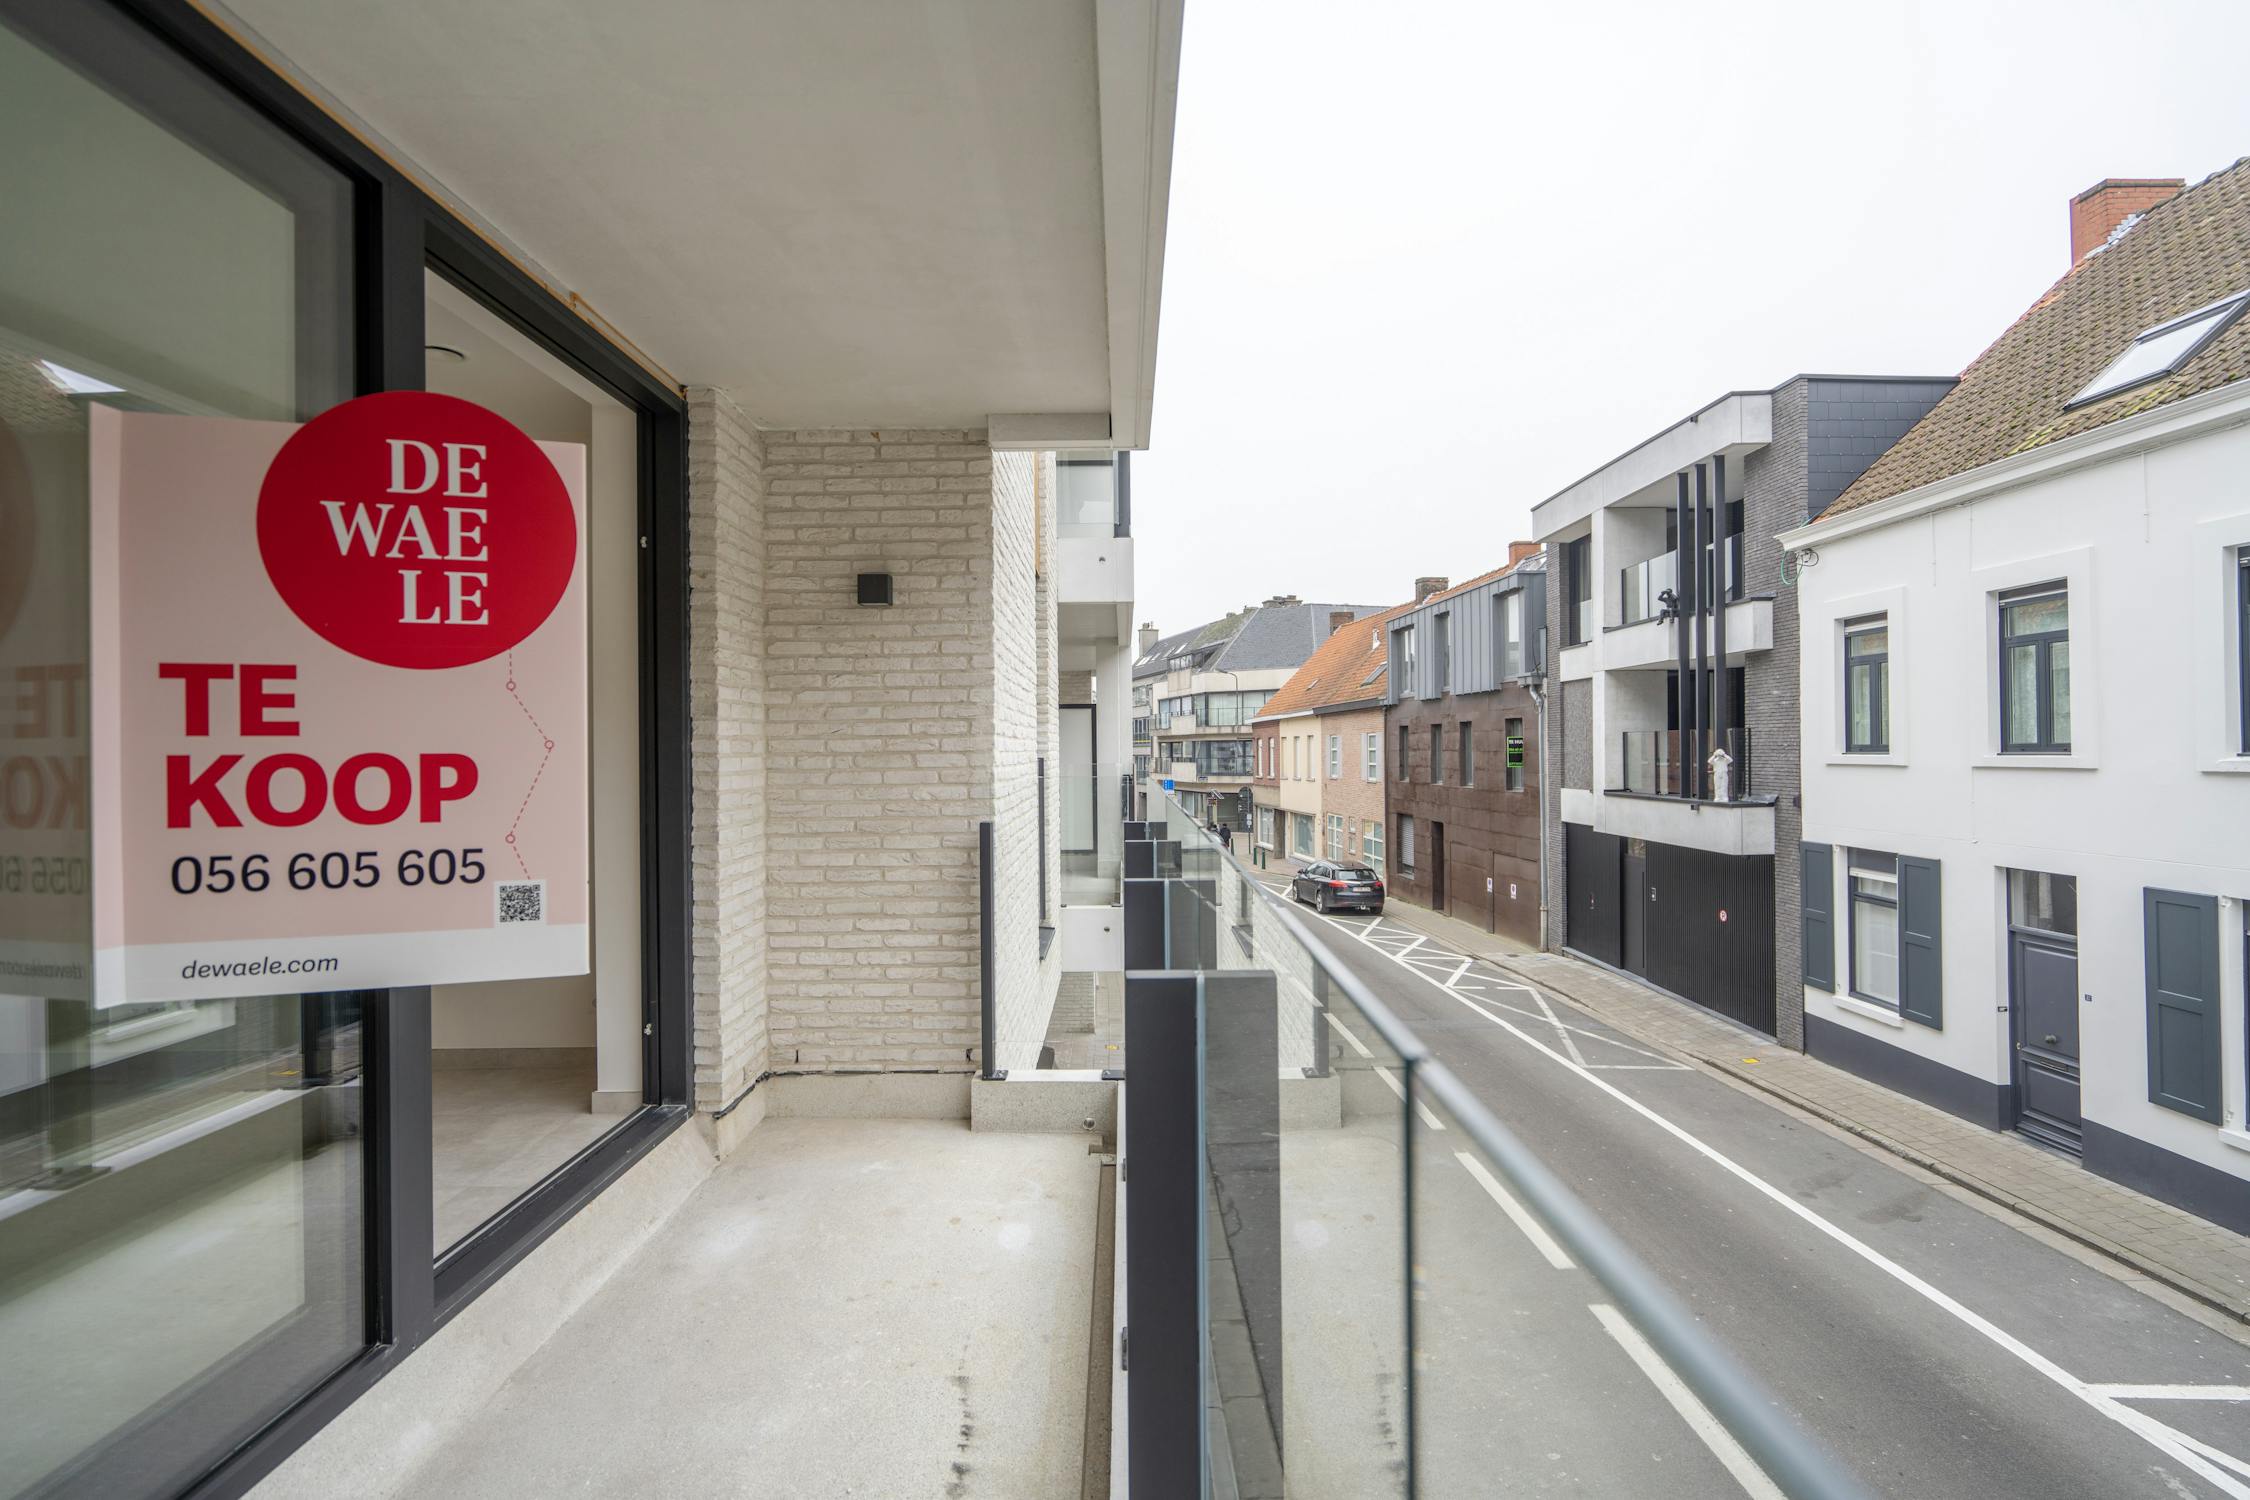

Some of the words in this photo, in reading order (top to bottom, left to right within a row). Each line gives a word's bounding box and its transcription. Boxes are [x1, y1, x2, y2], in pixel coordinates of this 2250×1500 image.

[386, 439, 487, 498] DE
[320, 500, 488, 562] WAE
[398, 569, 489, 625] LE
[158, 662, 300, 738] TE
[166, 752, 480, 829] KOOP
[171, 854, 271, 895] 056
[287, 851, 381, 891] 605
[396, 847, 486, 886] 605
[181, 955, 340, 980] dewaele.com
